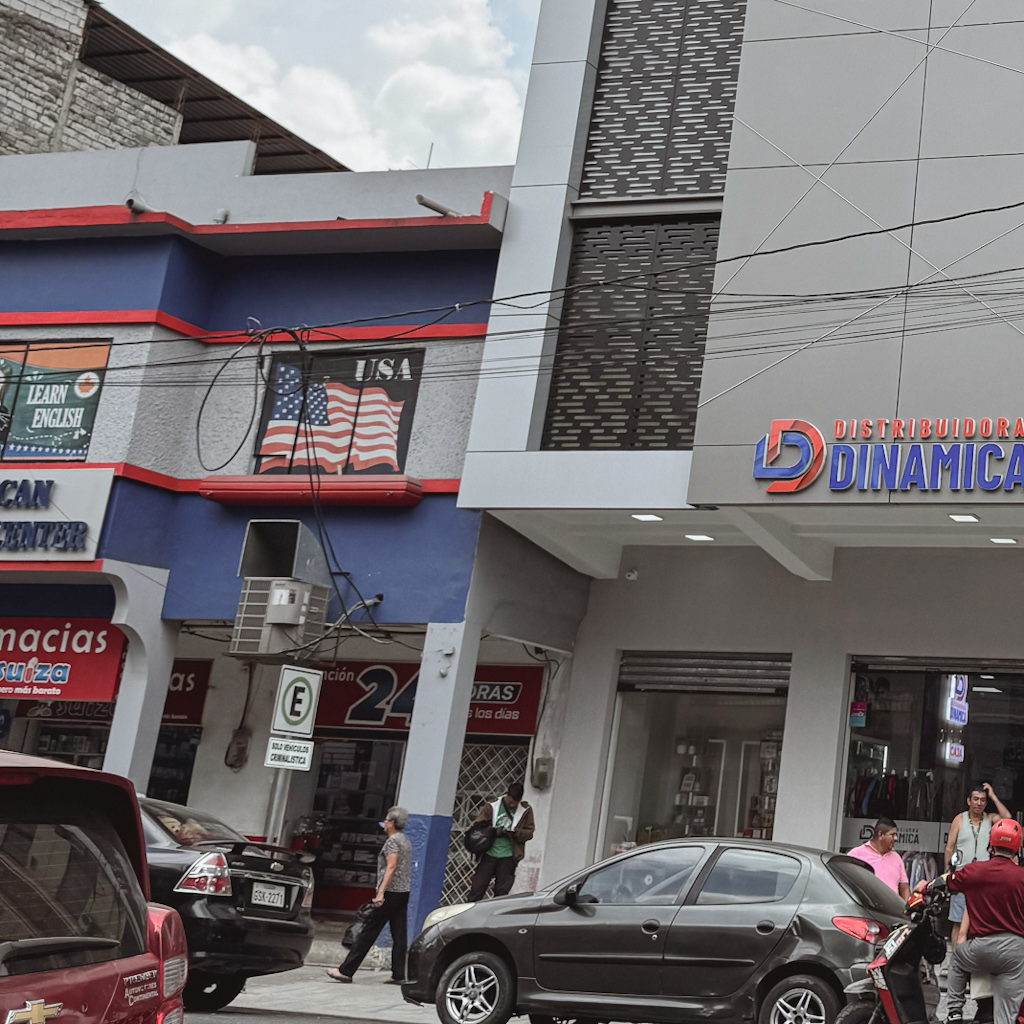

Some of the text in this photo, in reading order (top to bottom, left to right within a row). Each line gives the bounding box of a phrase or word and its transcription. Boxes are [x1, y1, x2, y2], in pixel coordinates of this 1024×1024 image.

[355, 358, 414, 381] USA
[26, 384, 69, 405] LEARN
[31, 407, 84, 428] ENGLISH
[289, 685, 306, 718] E
[474, 707, 494, 720] los
[494, 707, 521, 720] días
